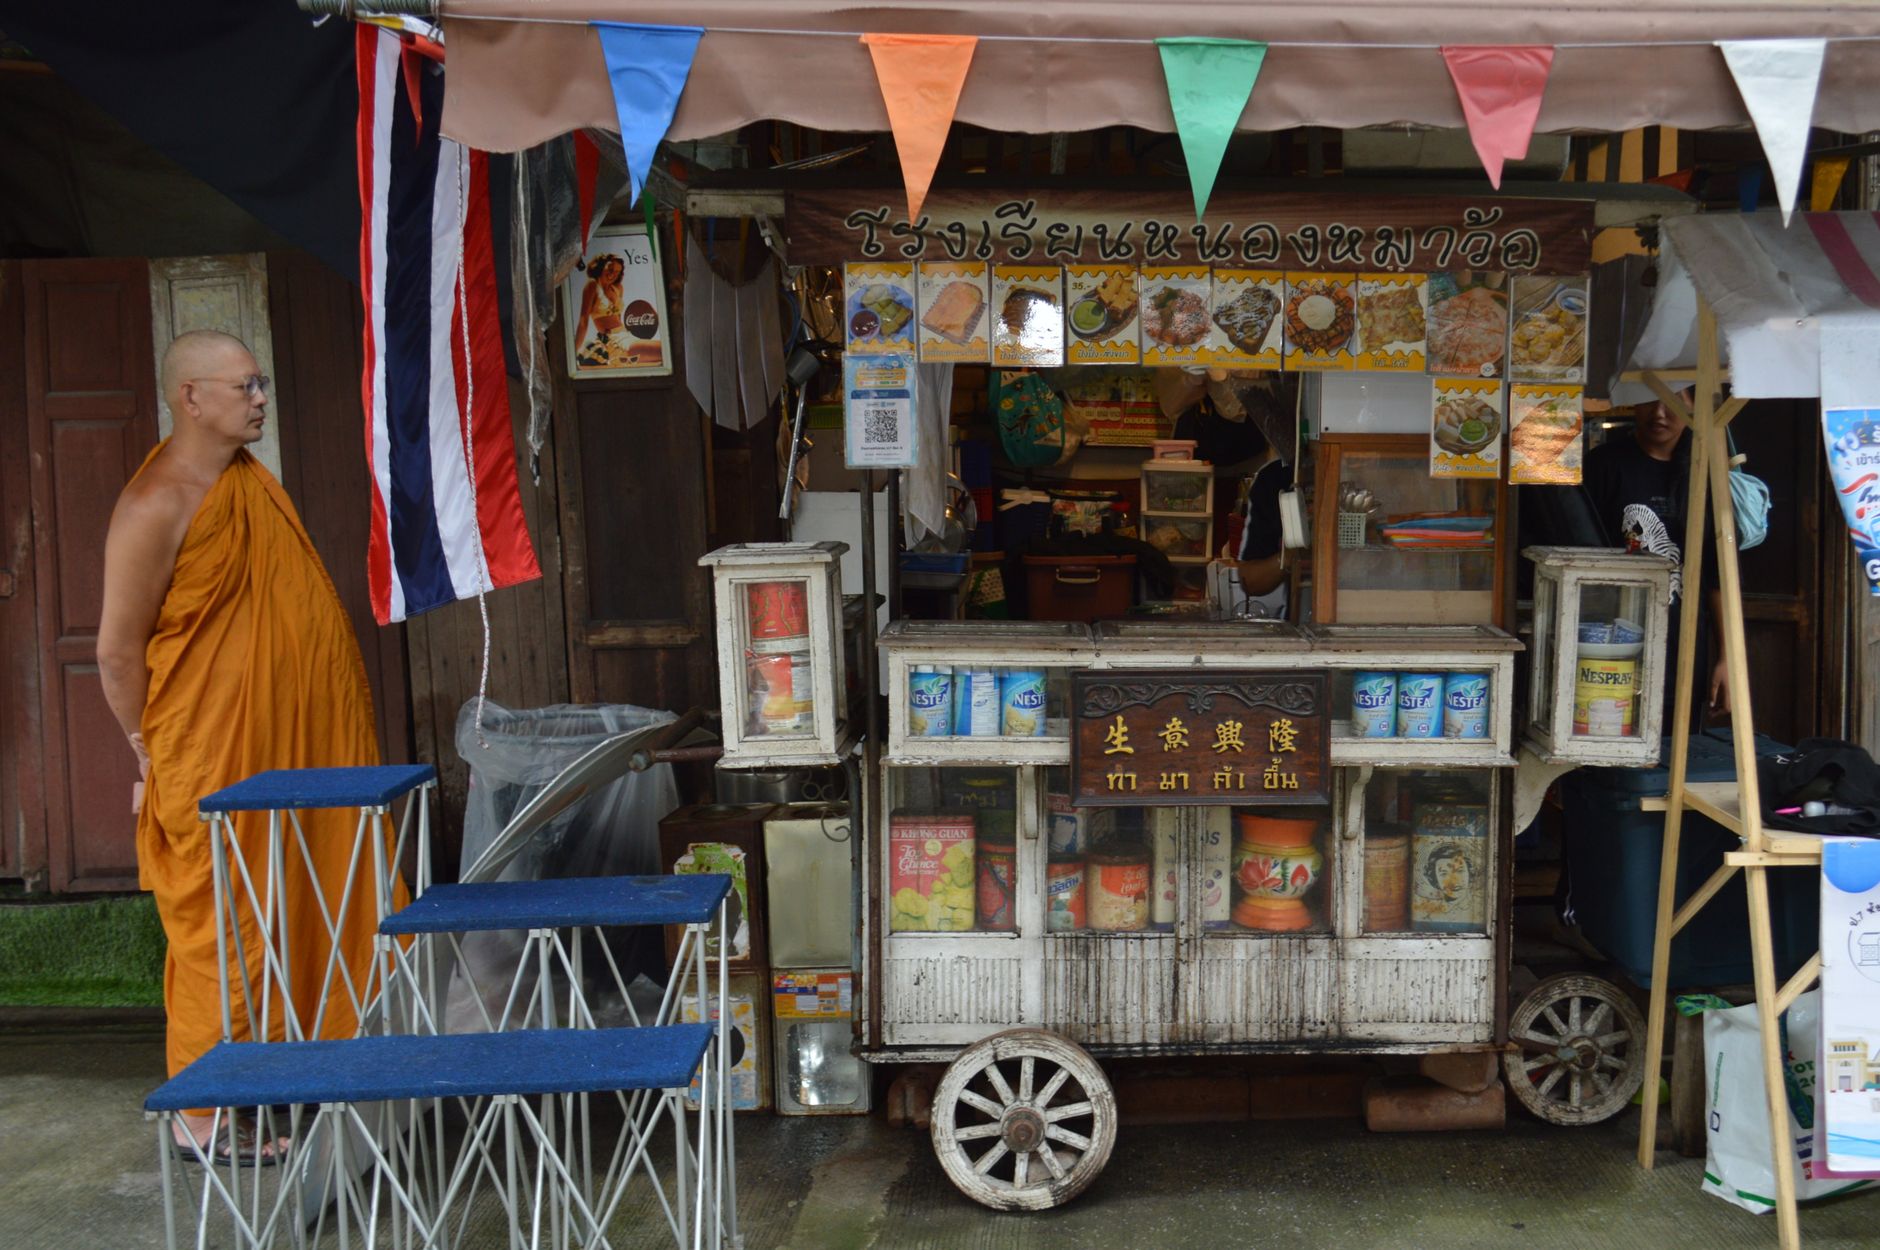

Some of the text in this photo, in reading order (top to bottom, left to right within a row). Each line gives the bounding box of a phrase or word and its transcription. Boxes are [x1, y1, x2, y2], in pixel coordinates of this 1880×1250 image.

[845, 201, 1541, 268] โรงเรียนหนองหมาว้อ
[625, 249, 648, 265] Yes
[1581, 668, 1632, 684] NESPRAY
[1354, 694, 1391, 706] NESTEA
[1400, 696, 1432, 708] ESTEA
[1104, 715, 1299, 754] 生意興隆
[1159, 771, 1190, 790] มา
[1213, 765, 1245, 790] ค้า
[1263, 756, 1299, 790] ขึ้น
[939, 829, 969, 839] GUAN
